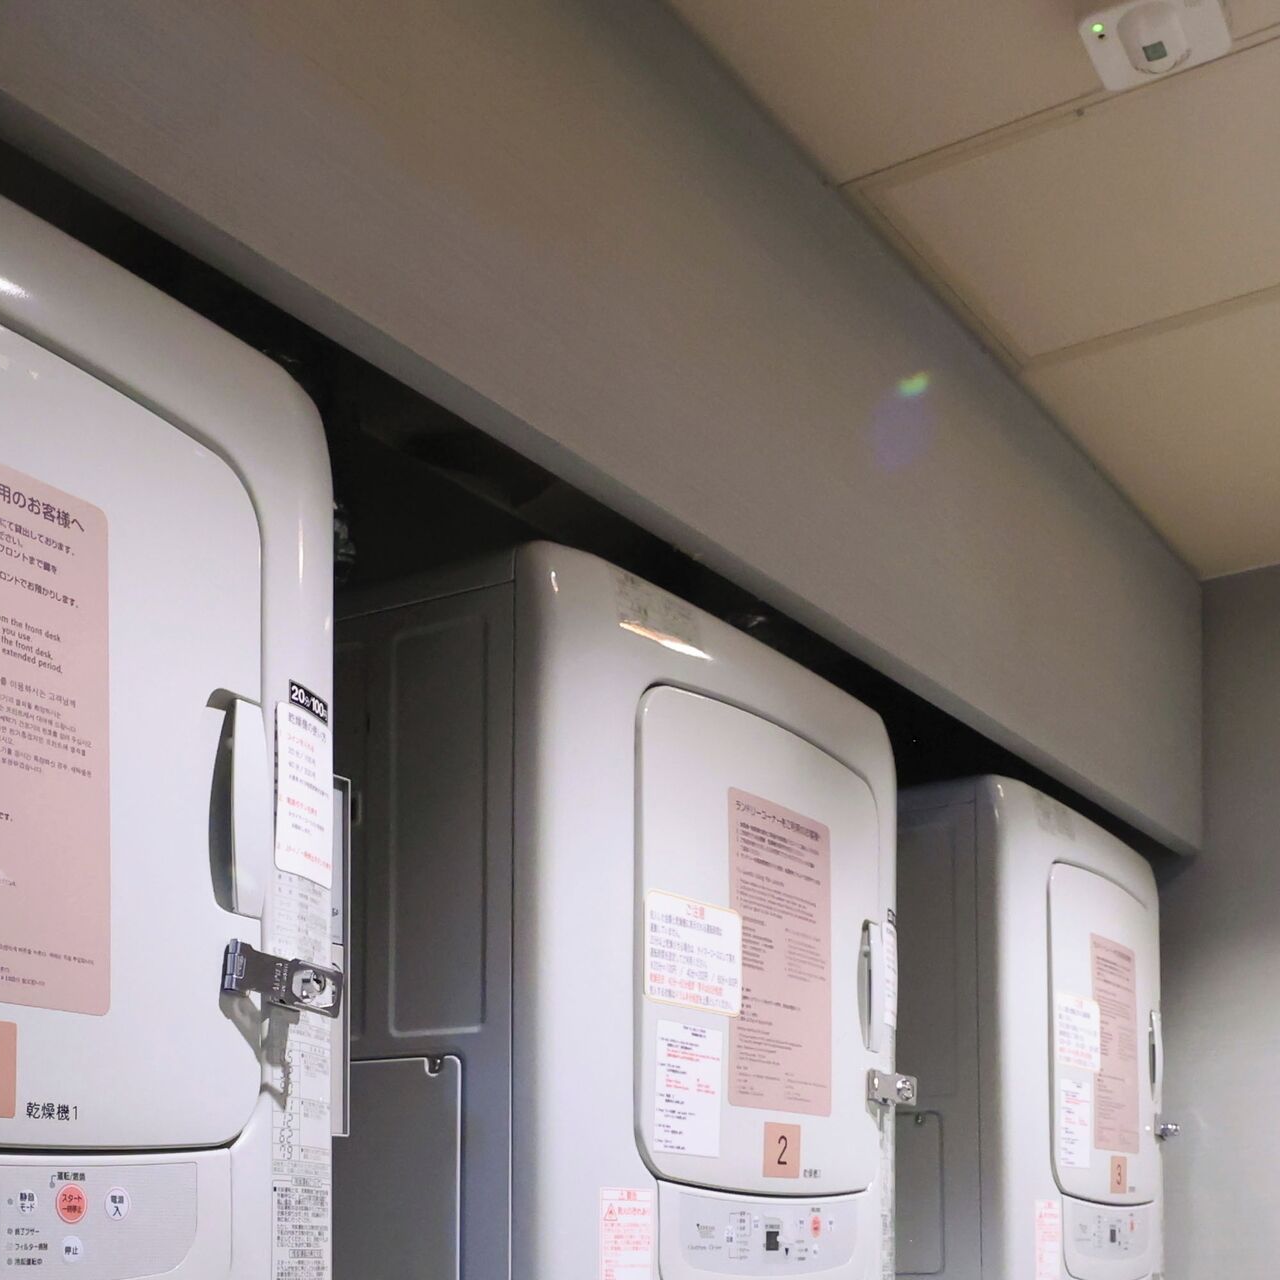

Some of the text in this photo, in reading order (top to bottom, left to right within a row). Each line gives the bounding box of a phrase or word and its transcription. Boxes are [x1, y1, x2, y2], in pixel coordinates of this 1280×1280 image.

[2, 627, 15, 636] you
[16, 640, 33, 652] front
[2, 646, 35, 664] extended
[26, 1102, 78, 1121] 乾燥機1
[777, 1135, 788, 1165] 2
[62, 1194, 82, 1202] スタート
[112, 1205, 122, 1216] 入
[64, 1247, 79, 1256] 停止
